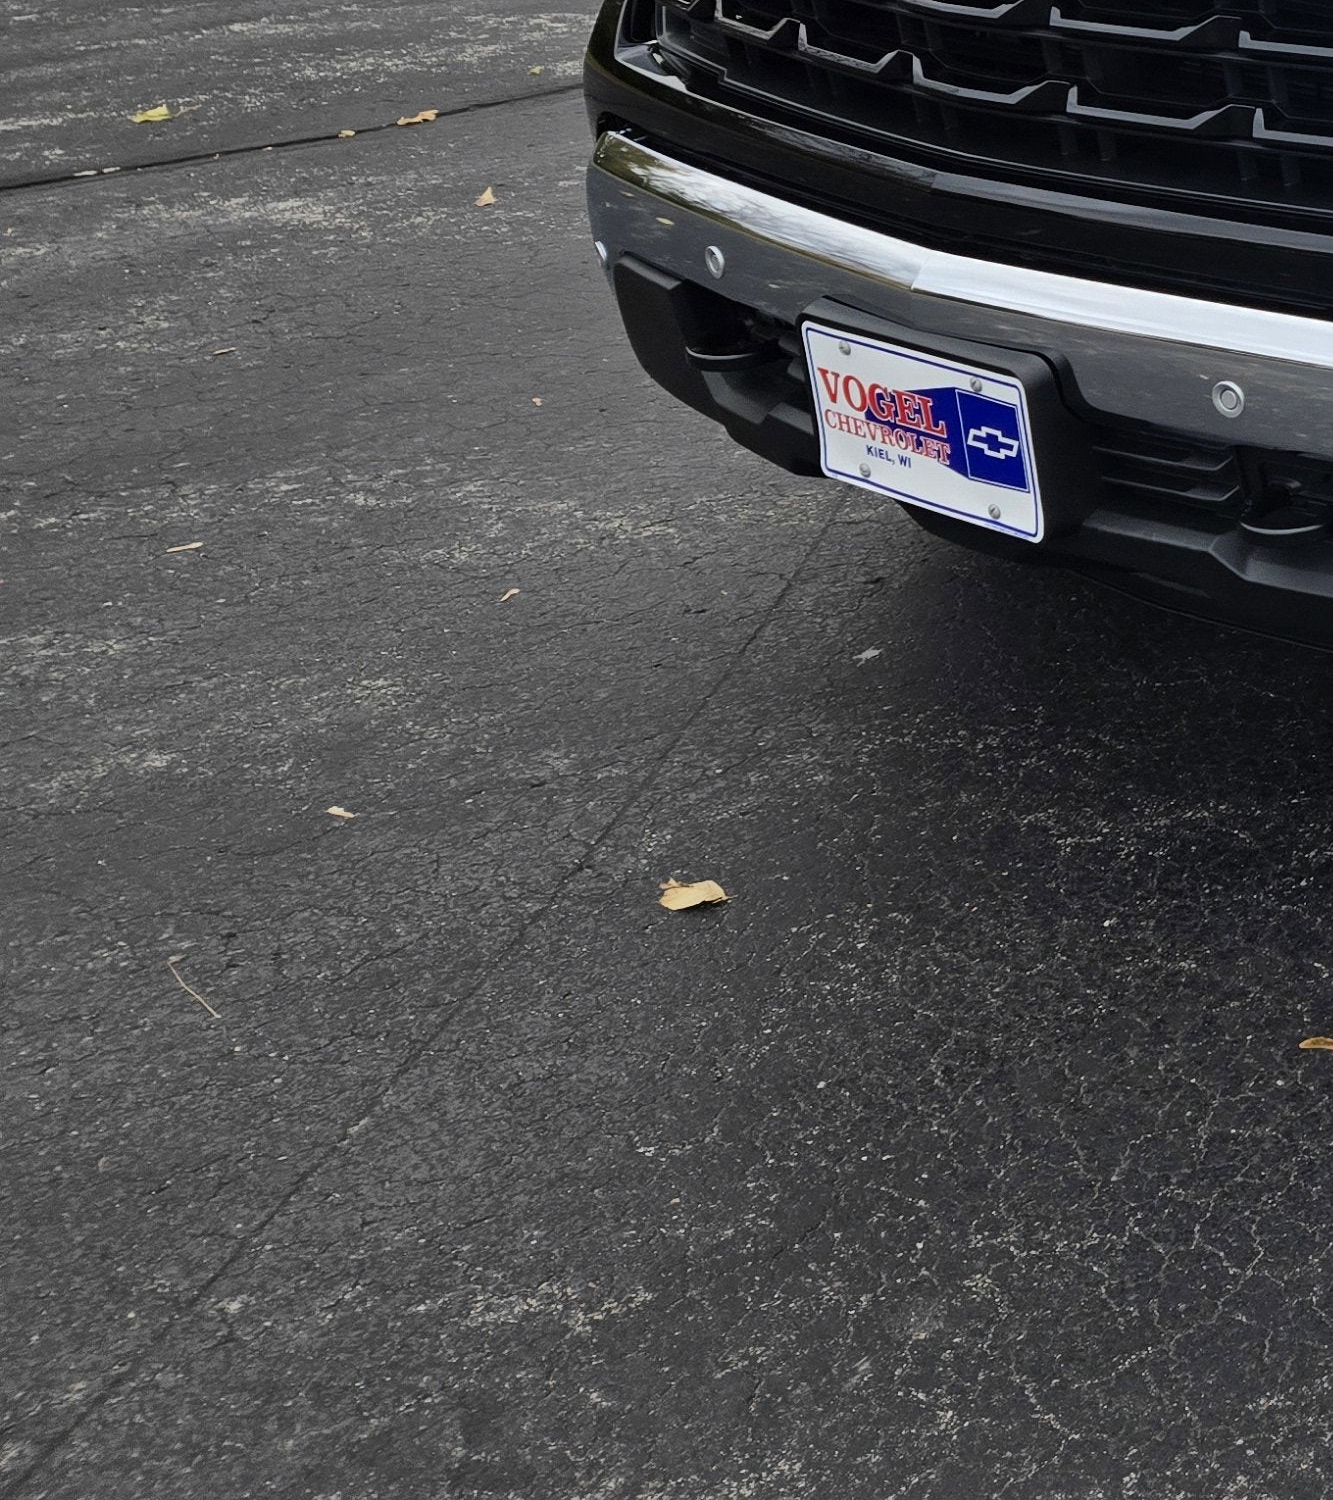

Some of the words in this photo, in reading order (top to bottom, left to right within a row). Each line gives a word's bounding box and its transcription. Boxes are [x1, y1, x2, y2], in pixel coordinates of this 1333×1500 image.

[817, 367, 948, 438] VOGEL
[824, 409, 951, 465] CHEVROLET
[866, 444, 896, 465] KIEL,
[897, 454, 912, 468] WI
